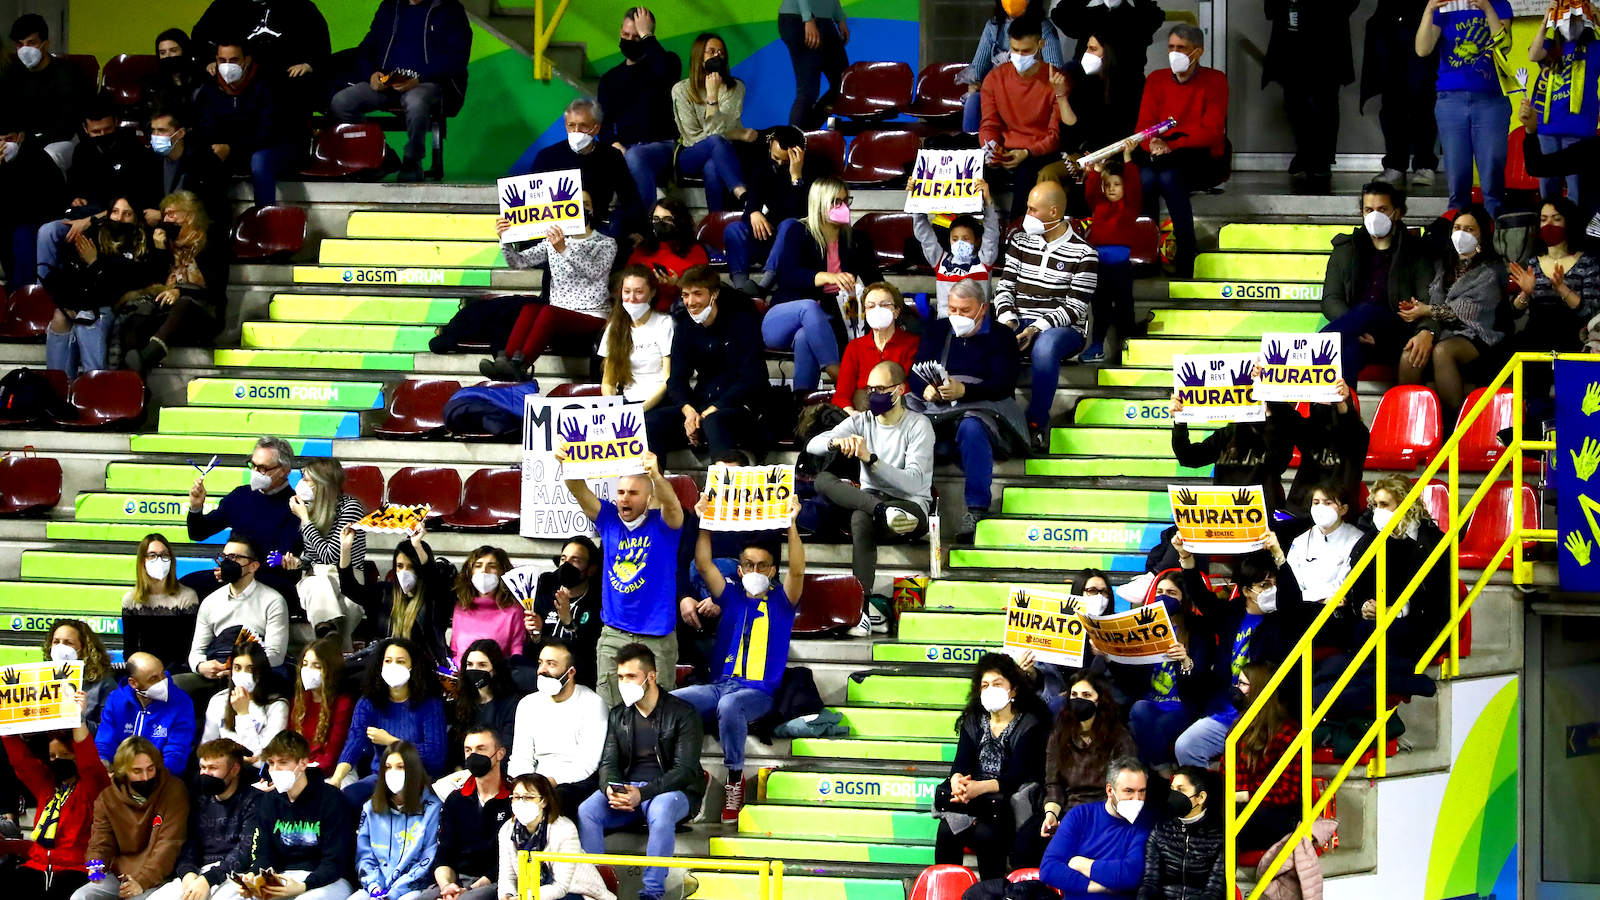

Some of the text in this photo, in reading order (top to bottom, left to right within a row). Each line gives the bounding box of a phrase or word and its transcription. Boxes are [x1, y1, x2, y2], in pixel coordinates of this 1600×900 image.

[941, 155, 953, 166] UP
[529, 179, 543, 190] UP
[529, 191, 544, 200] RENT
[504, 203, 580, 225] MURATO
[1293, 339, 1308, 350] UP
[1210, 360, 1225, 371] UP
[1210, 373, 1226, 381] RENT
[1260, 367, 1337, 384] MURATO
[1178, 388, 1258, 405] MURATO
[592, 414, 606, 425] UP
[565, 440, 644, 461] MURATO
[1175, 508, 1263, 524] MURATO
[1008, 610, 1083, 636] MURATO
[0, 683, 78, 704] MURATO
